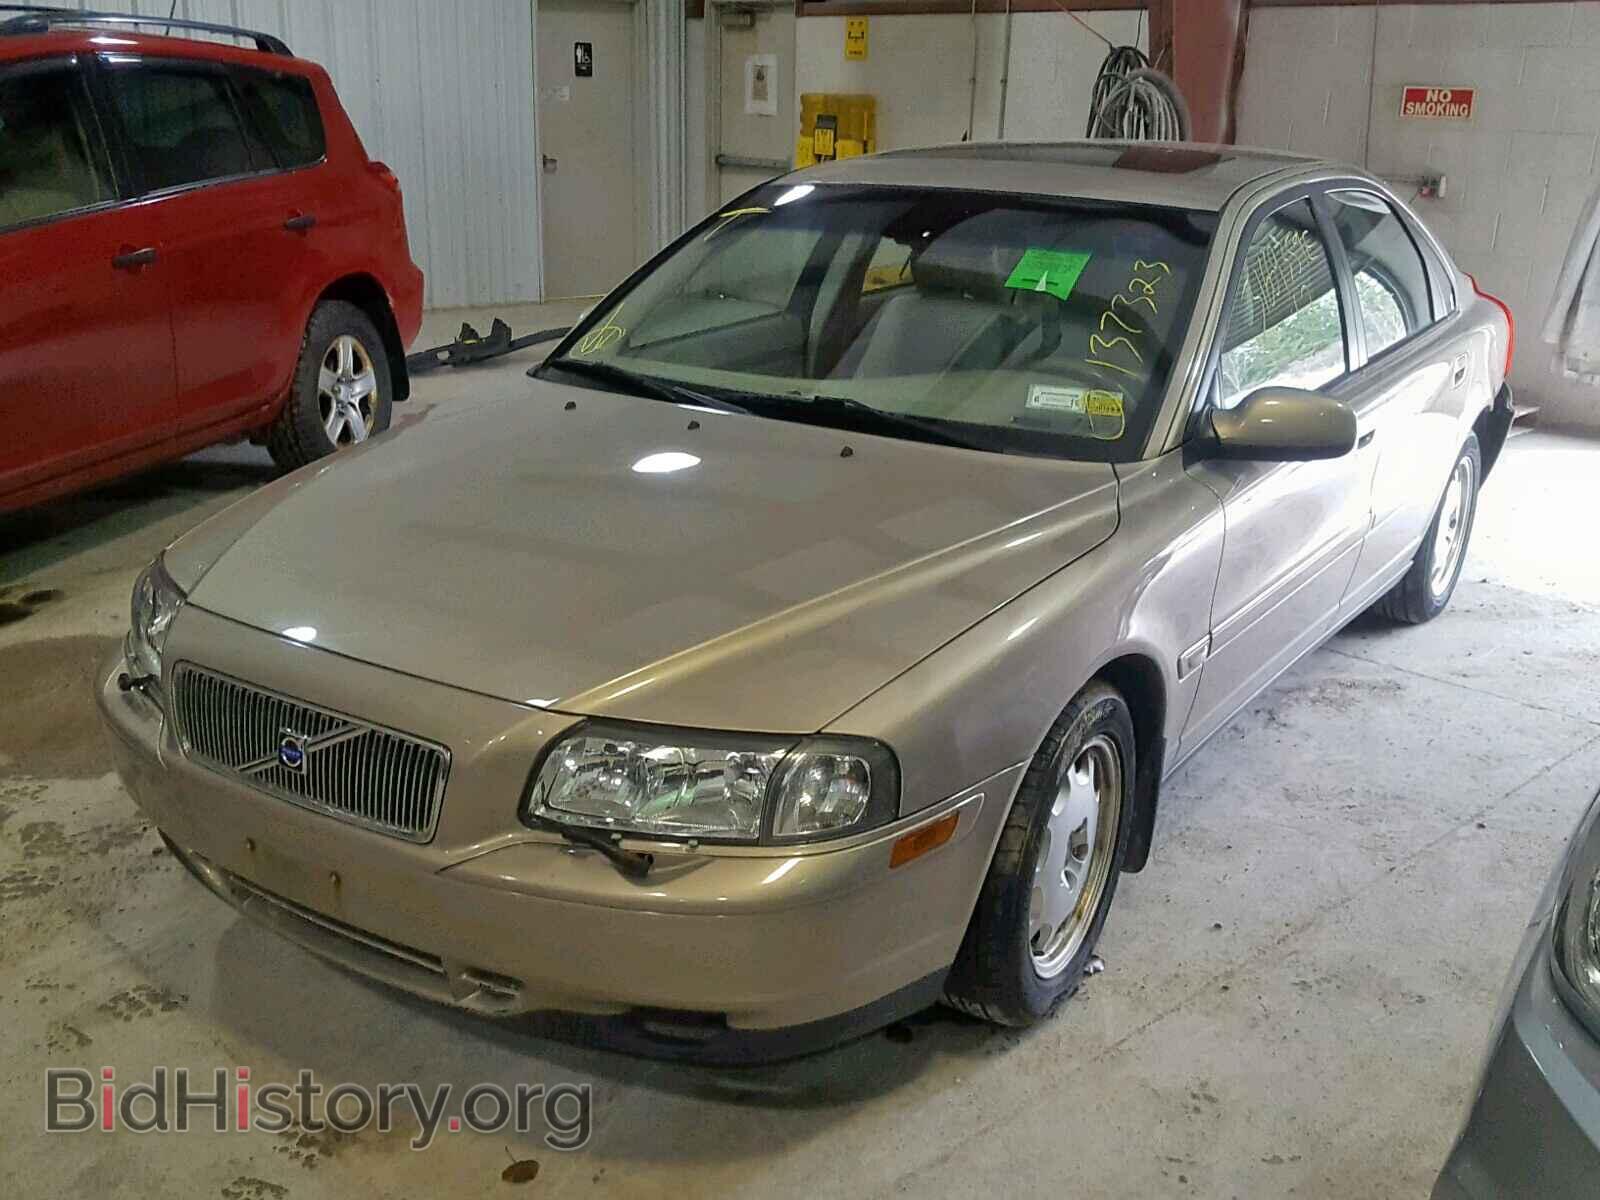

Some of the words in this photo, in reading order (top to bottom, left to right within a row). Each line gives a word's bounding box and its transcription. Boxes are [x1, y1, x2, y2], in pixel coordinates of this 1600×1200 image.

[1426, 89, 1452, 102] NO
[1406, 102, 1469, 116] SMOKING
[1085, 259, 1171, 379] 137323
